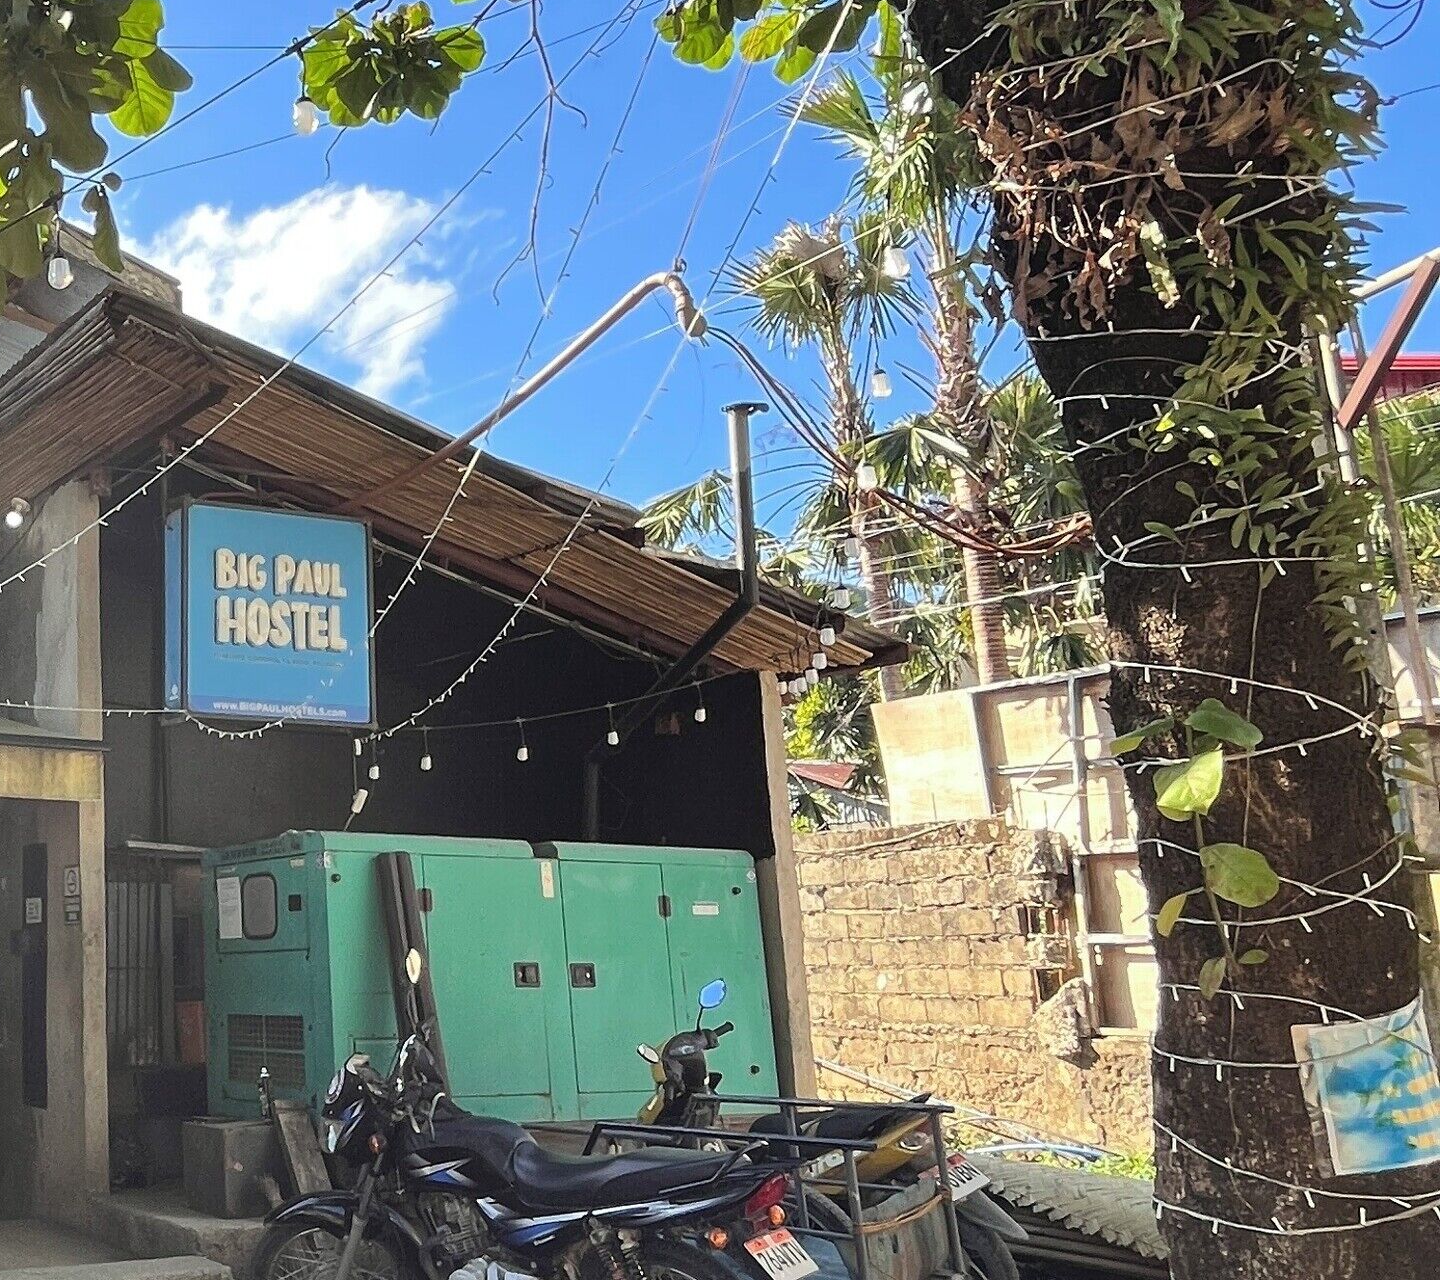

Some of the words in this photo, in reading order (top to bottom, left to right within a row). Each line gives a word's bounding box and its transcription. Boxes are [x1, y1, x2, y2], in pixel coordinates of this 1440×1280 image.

[215, 548, 268, 591] BIG
[274, 554, 348, 598] PAUL
[215, 595, 349, 653] HOSTEL
